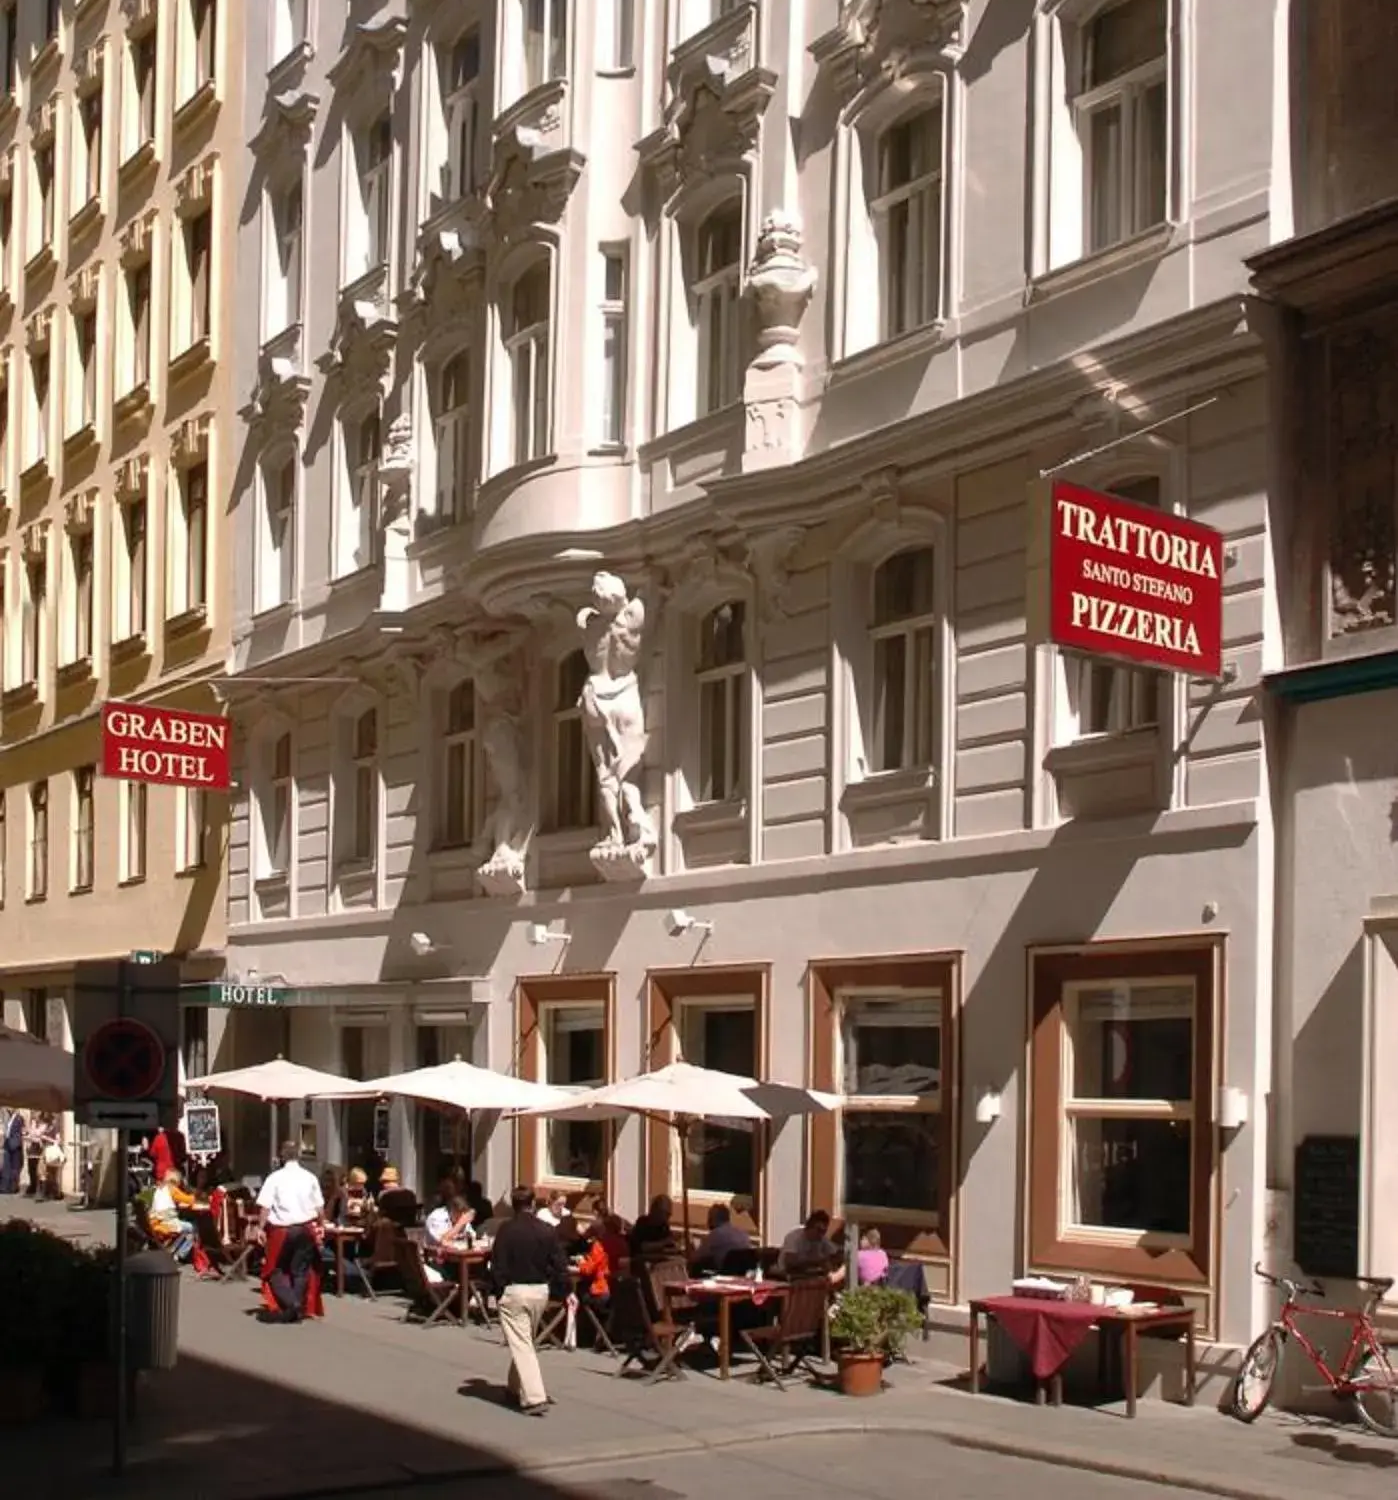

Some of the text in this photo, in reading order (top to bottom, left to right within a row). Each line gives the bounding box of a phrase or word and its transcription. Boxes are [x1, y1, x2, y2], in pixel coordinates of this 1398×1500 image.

[1057, 500, 1218, 579] TRATTORIA
[1082, 559, 1193, 605] SANTO STEFANO
[1071, 591, 1202, 655] PIZZERIA
[107, 711, 227, 749] GRABEN
[118, 747, 215, 781] HOTEL
[221, 986, 277, 1005] HOTEL
